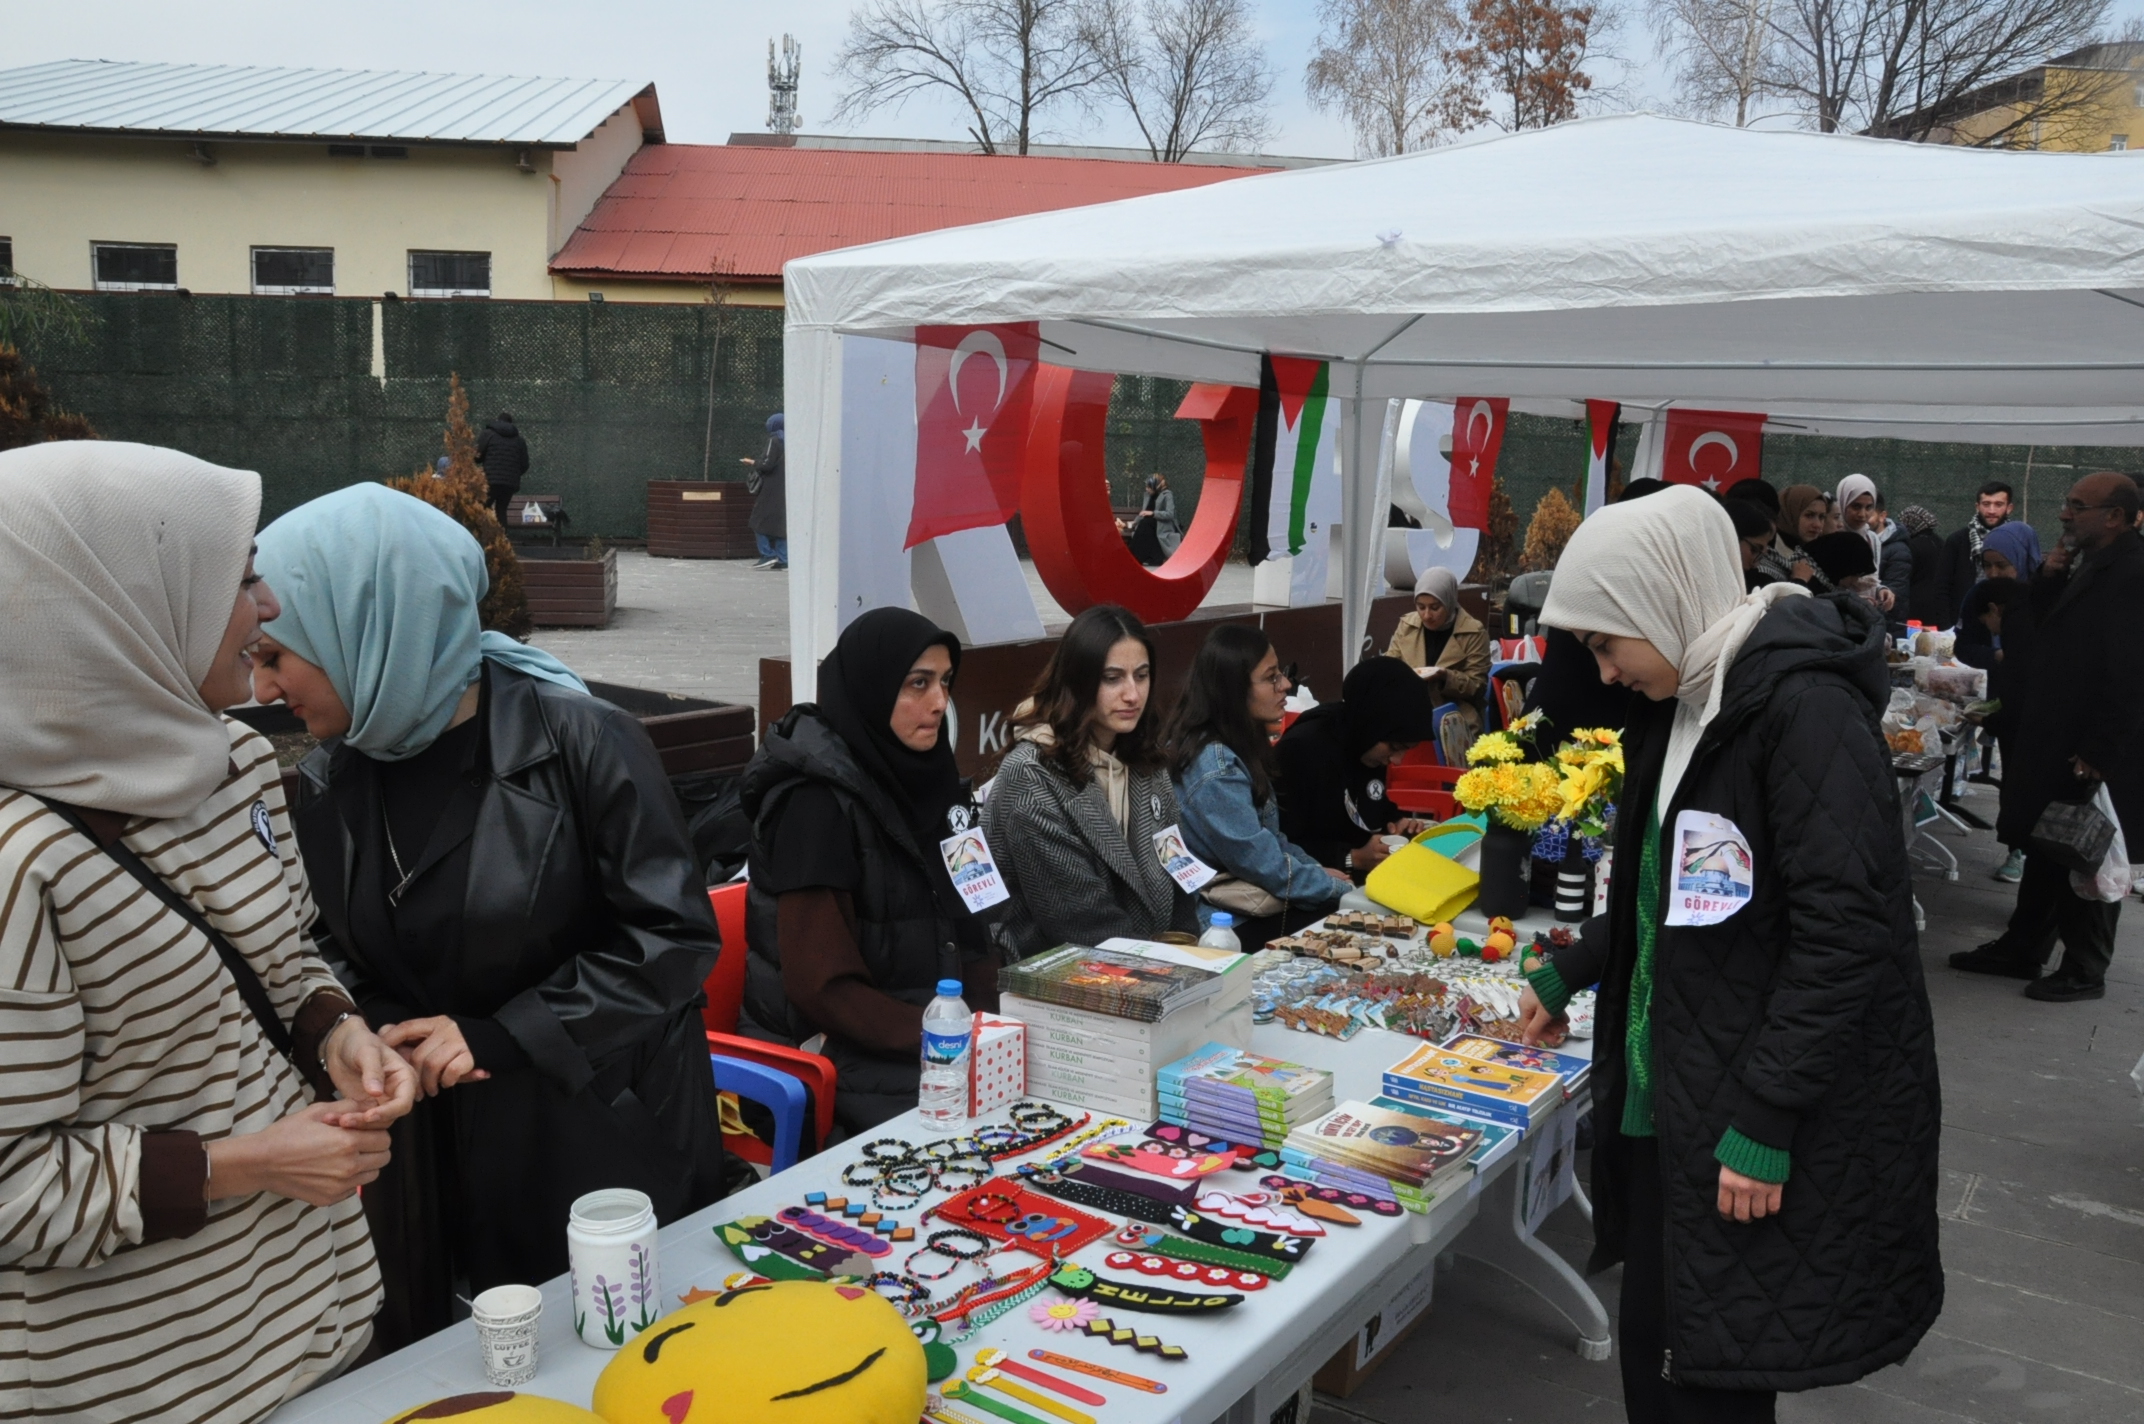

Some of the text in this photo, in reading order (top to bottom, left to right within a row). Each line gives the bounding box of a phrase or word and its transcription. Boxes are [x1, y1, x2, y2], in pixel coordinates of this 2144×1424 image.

[962, 874, 996, 897] GÖREVLİ
[1684, 895, 1742, 912] GÖREVLİ
[1049, 1013, 1084, 1026] KURBAN
[938, 1039, 962, 1049] desni
[1049, 1031, 1084, 1046] KURBAN
[1049, 1050, 1083, 1065] KURBAN
[1051, 1070, 1085, 1084] KURBAN
[1051, 1089, 1085, 1103] KURBAN
[1093, 1283, 1228, 1307] HELLO
[493, 1341, 530, 1351] COFFEE
